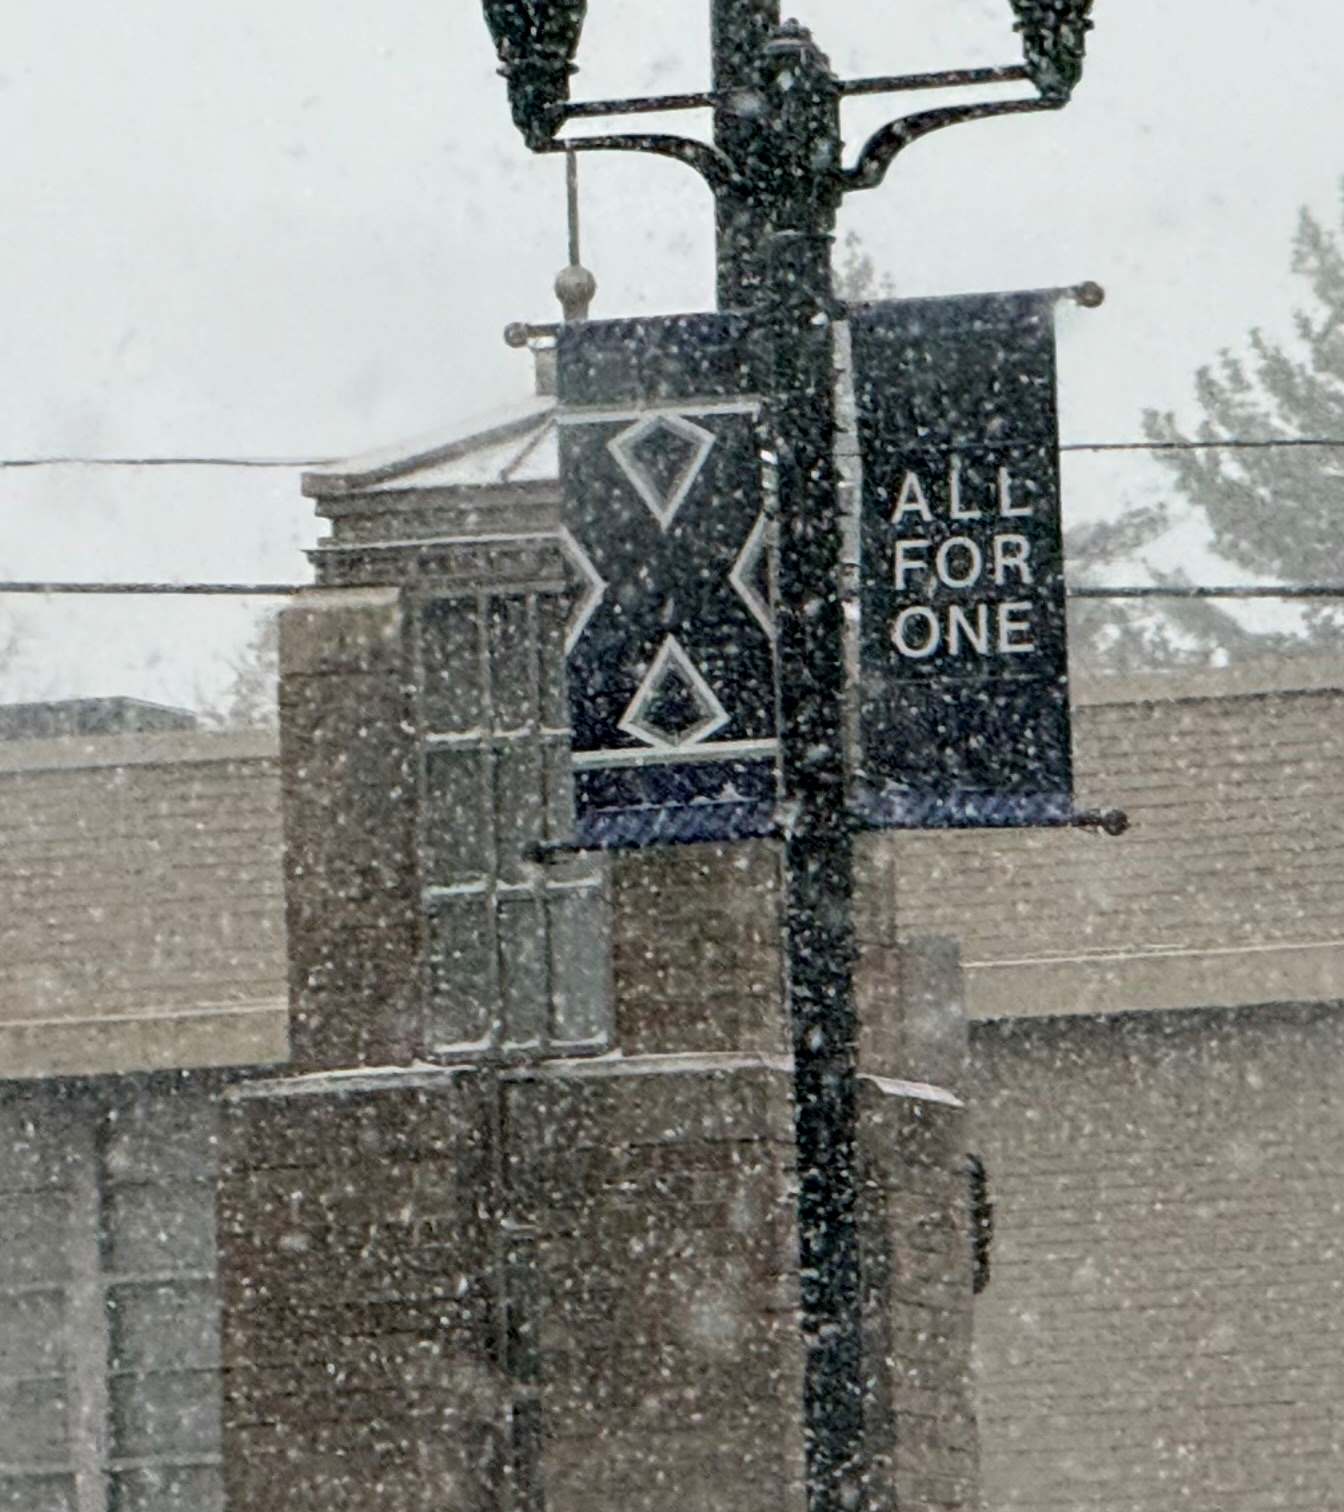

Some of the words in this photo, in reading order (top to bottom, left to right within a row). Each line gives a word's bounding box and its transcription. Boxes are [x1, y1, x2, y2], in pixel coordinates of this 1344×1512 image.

[891, 467, 1033, 524] ALL
[894, 534, 1033, 590] FOR
[891, 602, 1035, 658] ONE
